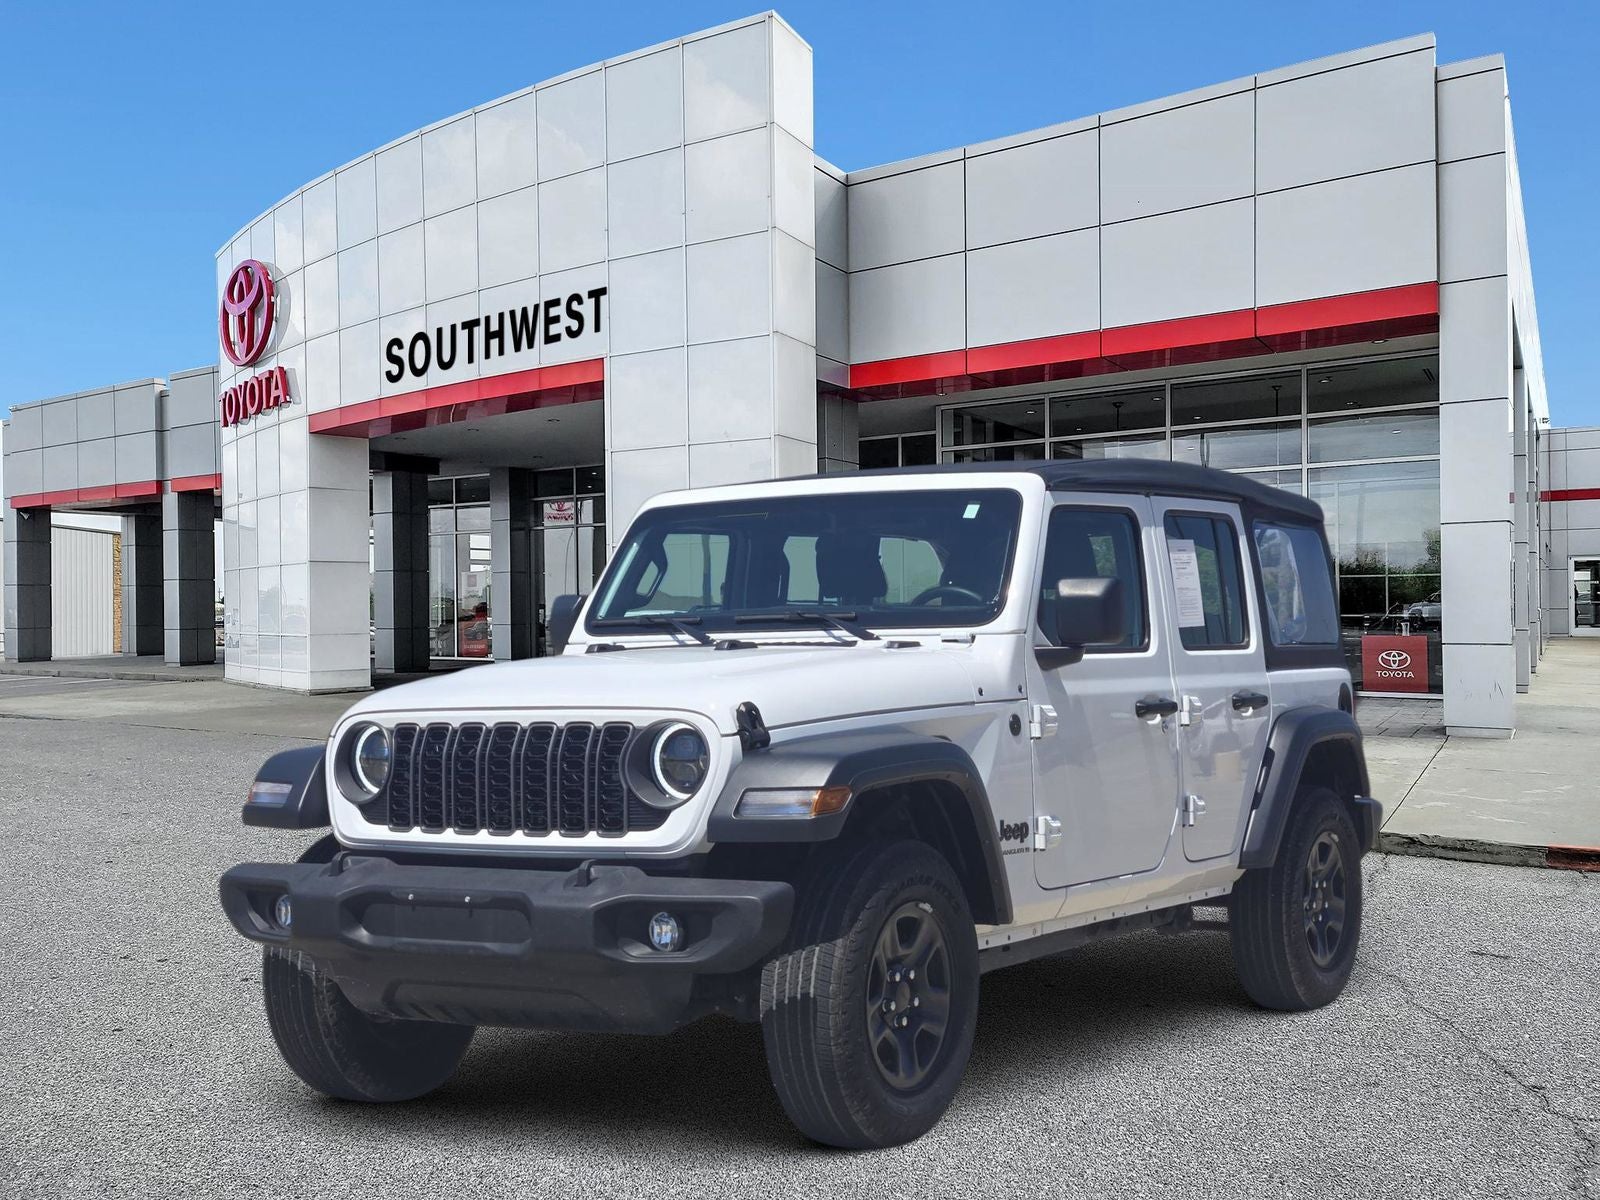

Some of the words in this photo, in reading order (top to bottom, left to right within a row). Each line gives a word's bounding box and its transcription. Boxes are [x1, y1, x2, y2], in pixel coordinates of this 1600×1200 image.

[385, 287, 608, 384] SOUTHWEST
[218, 366, 290, 428] TOYOTA
[1376, 670, 1415, 678] TOYOTA
[999, 819, 1030, 843] Jeep
